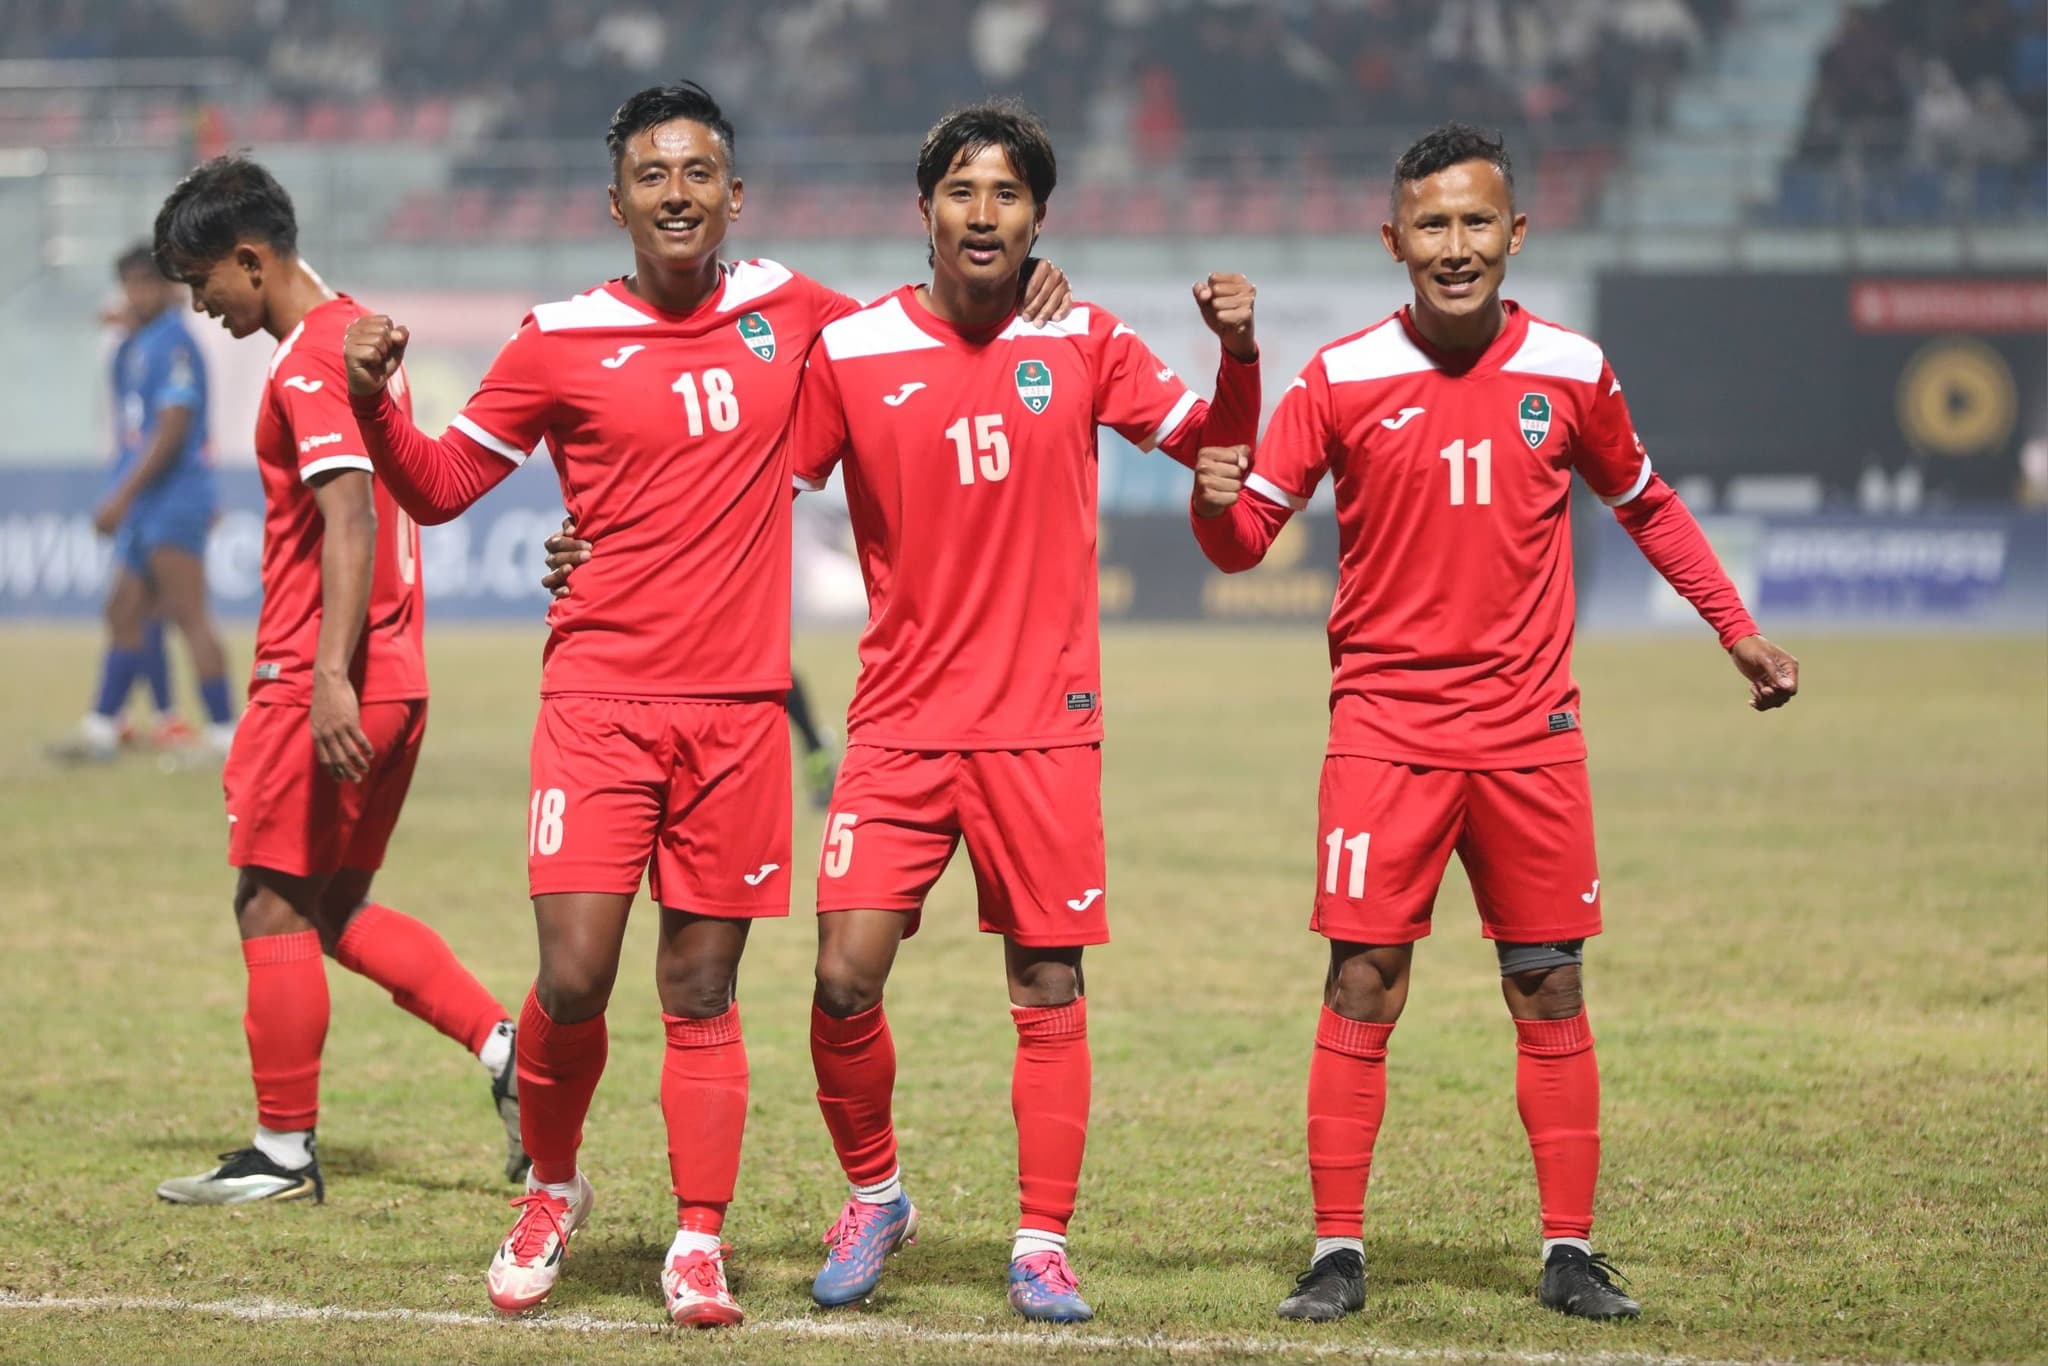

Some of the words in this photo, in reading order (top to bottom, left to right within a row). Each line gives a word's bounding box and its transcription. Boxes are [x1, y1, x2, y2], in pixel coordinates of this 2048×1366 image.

[671, 368, 740, 437] 18
[945, 413, 1011, 486] 15
[1440, 438, 1492, 506] 11
[529, 788, 566, 857] 18
[822, 812, 857, 879] 5
[1325, 827, 1371, 899] 11
